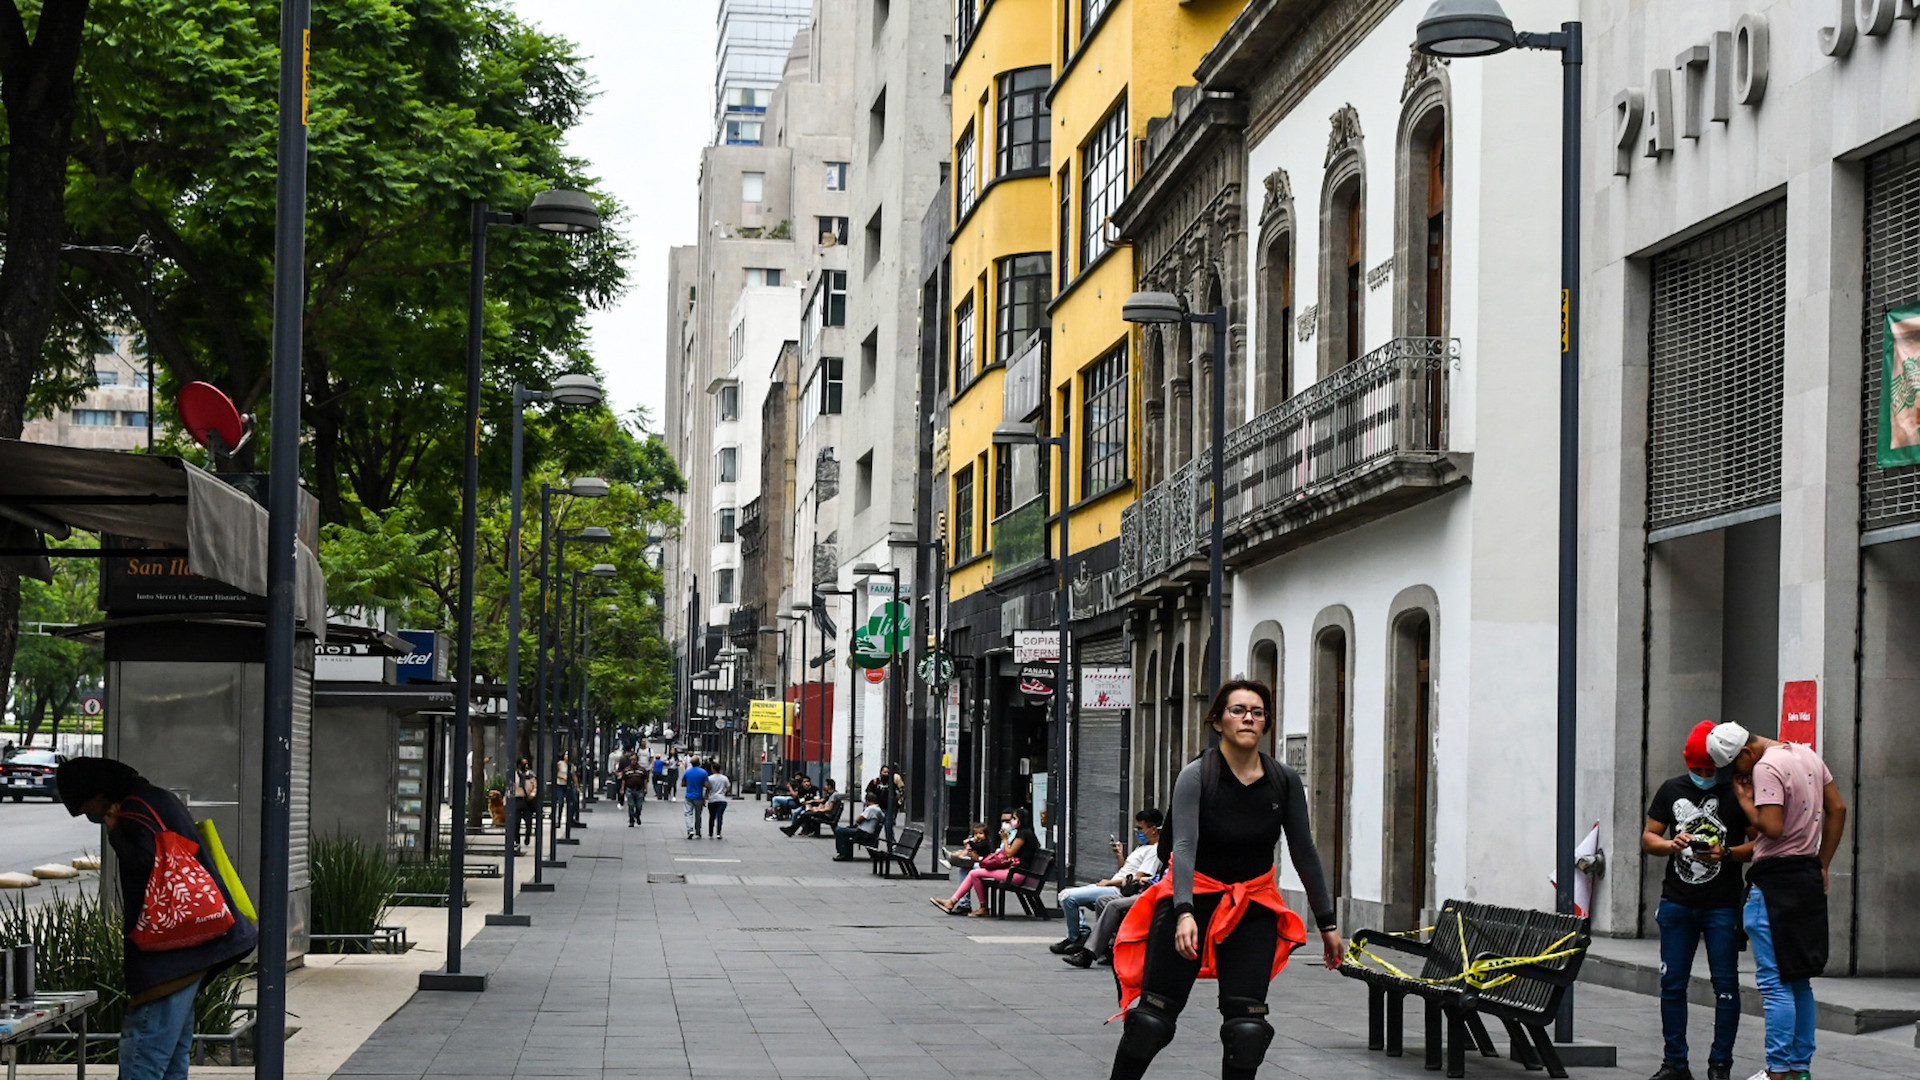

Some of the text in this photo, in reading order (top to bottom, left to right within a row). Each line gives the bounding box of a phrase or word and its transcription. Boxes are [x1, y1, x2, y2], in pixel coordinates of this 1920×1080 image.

[1613, 12, 1769, 176] PATIO
[127, 558, 163, 576] San
[870, 585, 911, 593] FARMCIA
[1022, 637, 1060, 645] COPIAS
[1016, 649, 1060, 657] INTERNE
[396, 652, 432, 665] elcel
